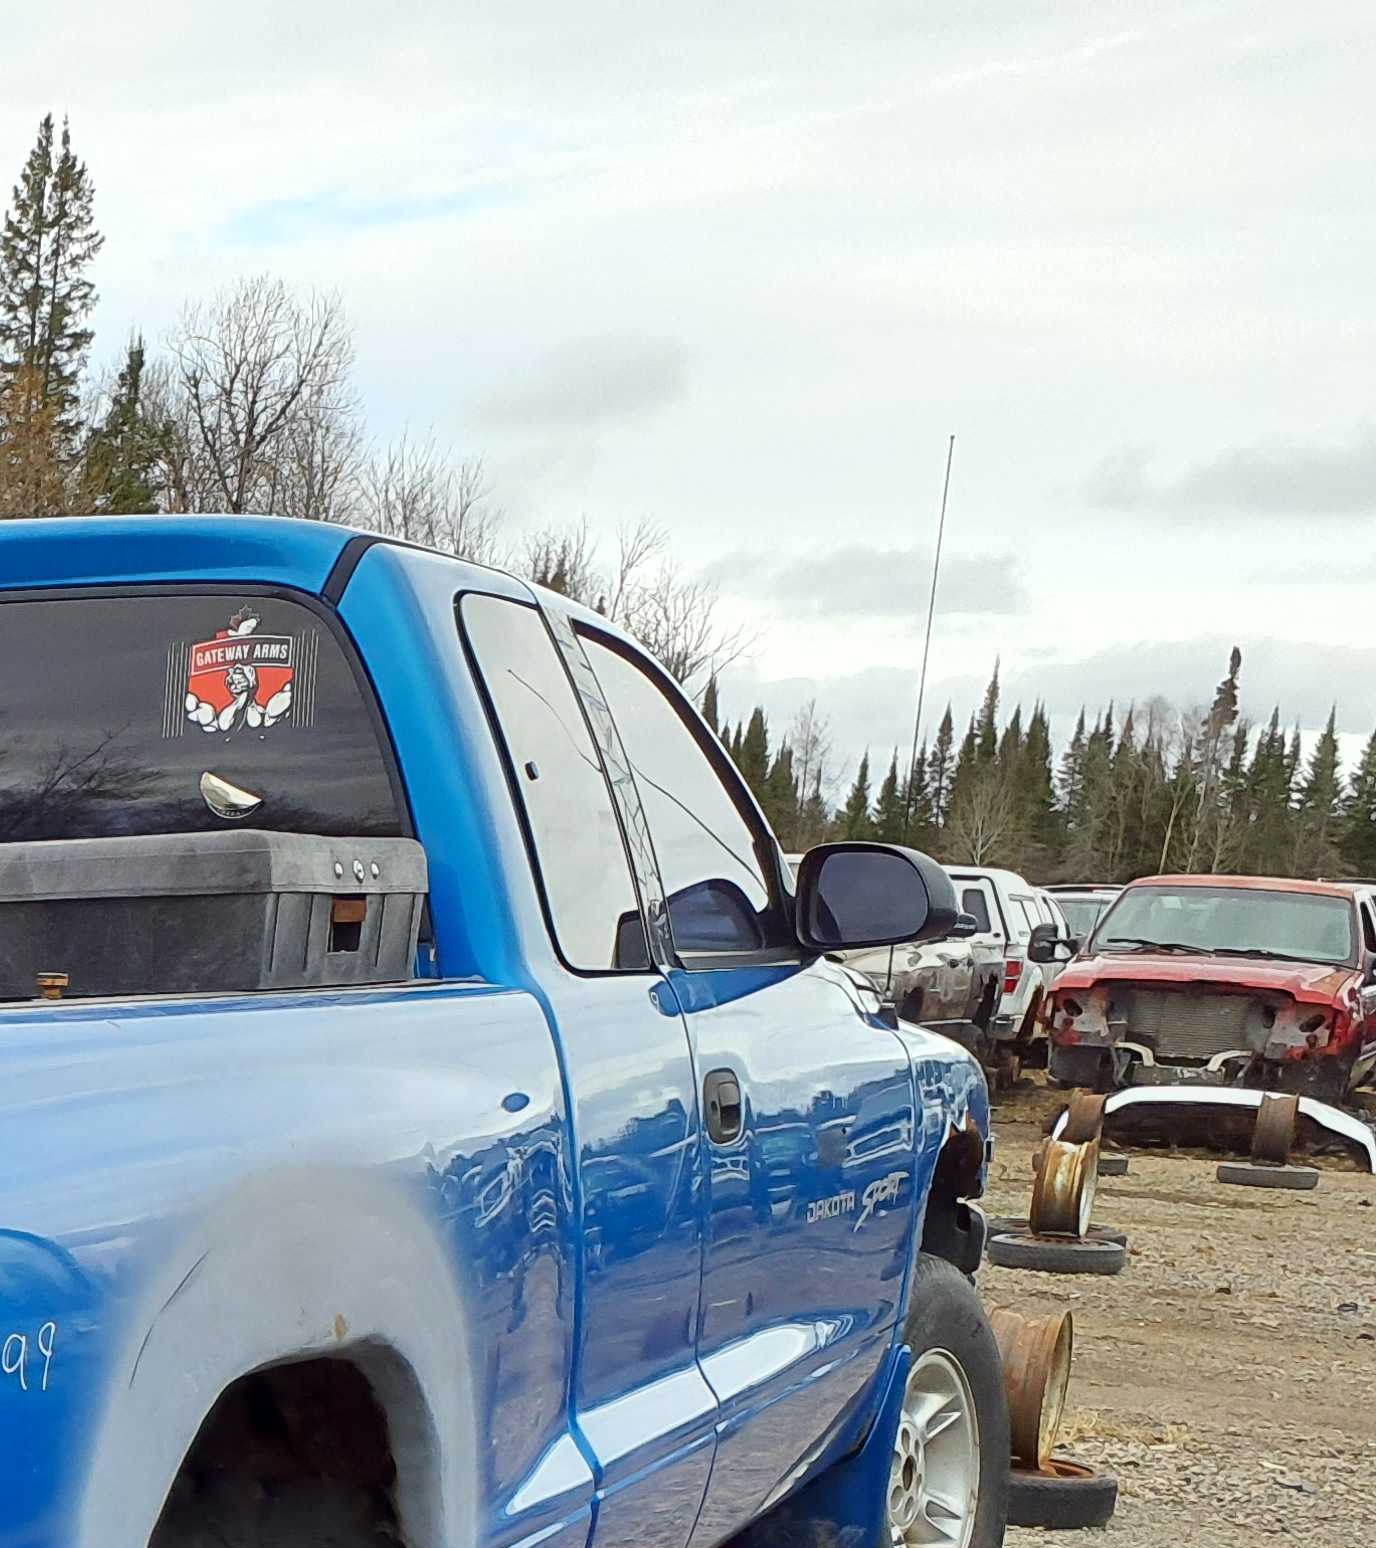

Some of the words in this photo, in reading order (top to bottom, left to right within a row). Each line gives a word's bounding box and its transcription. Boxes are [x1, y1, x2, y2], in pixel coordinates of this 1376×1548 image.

[196, 644, 250, 667] GATEWAY
[253, 644, 289, 660] ARMS
[807, 1190, 855, 1224] DAKOTA
